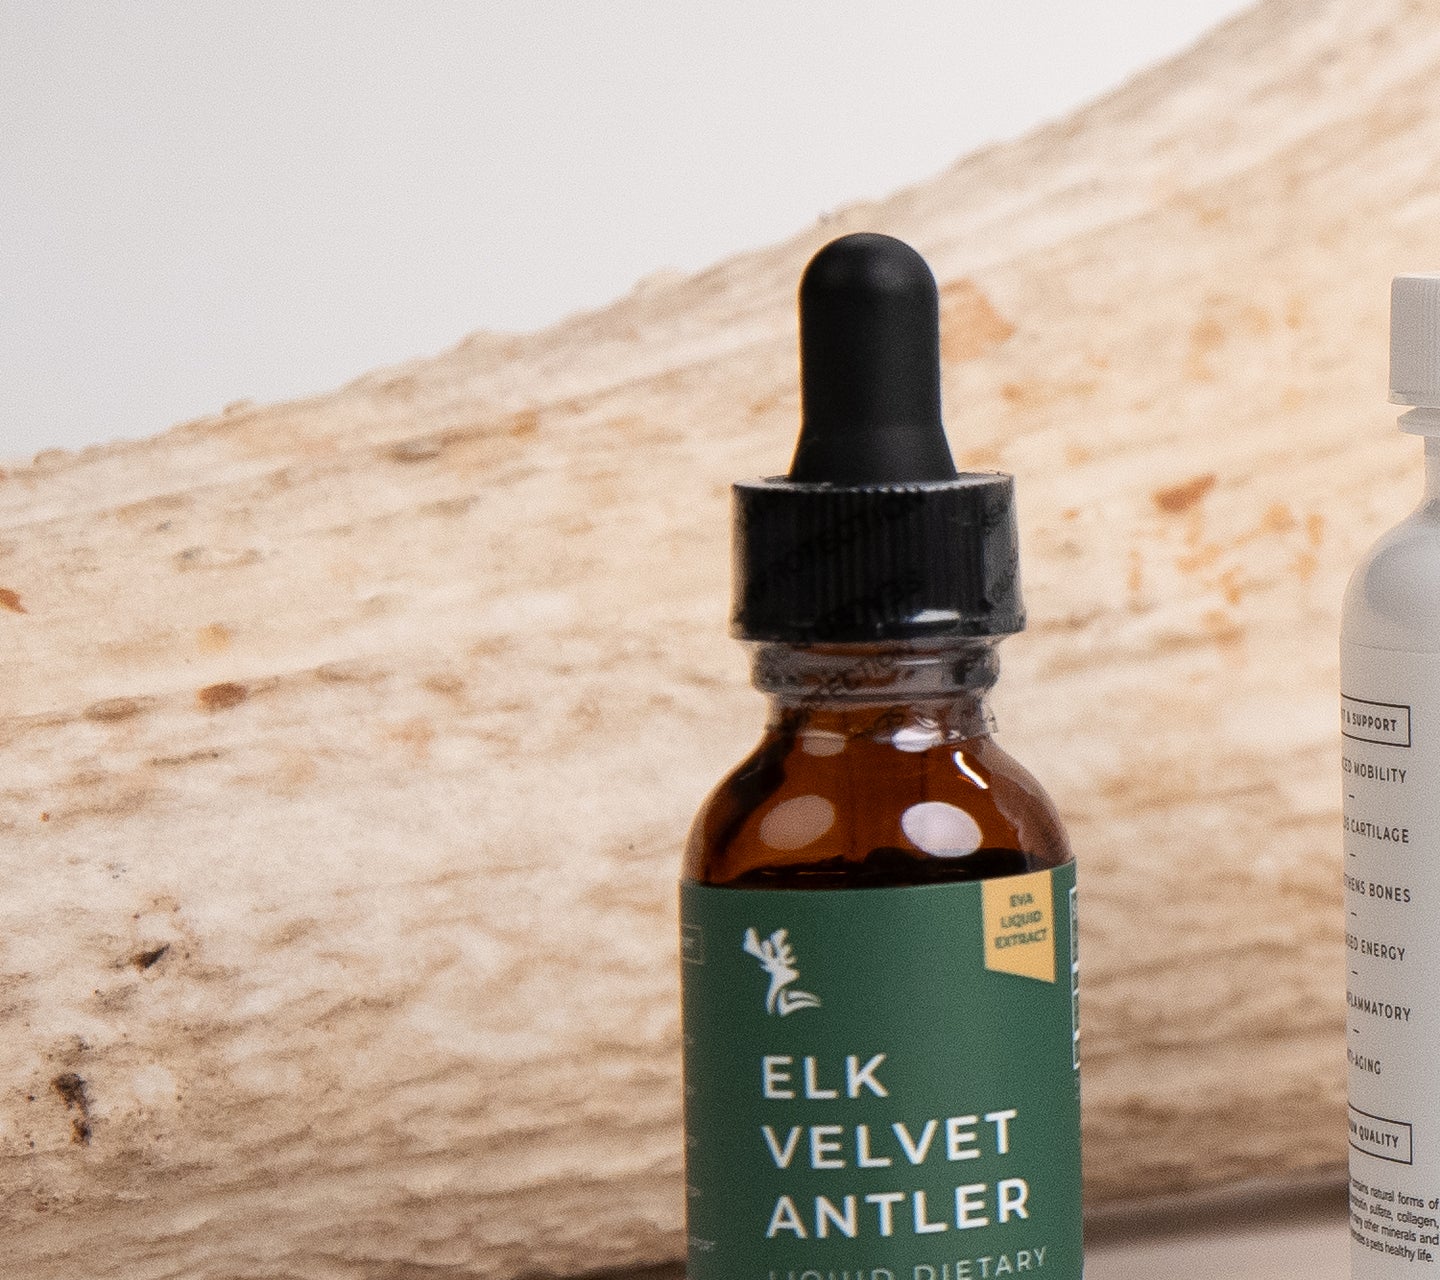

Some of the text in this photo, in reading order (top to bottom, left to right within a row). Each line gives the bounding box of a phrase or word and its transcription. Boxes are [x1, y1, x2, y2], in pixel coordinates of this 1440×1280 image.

[1352, 712, 1398, 732] SUPPORT
[1354, 761, 1407, 784] MOBILITY
[1351, 819, 1410, 843] CARTILAGE
[1009, 892, 1035, 909] EVA
[1369, 882, 1411, 903] BONES
[1001, 910, 1043, 929] LIQUID
[994, 928, 1048, 950] EXTRACT
[1361, 939, 1406, 962] ENERGY
[761, 1052, 890, 1101] ELK
[760, 1108, 1019, 1171] VELVET
[1358, 1125, 1400, 1149] QUALITY
[764, 1177, 1031, 1240] ANTLER
[1397, 1192, 1425, 1209] forms
[1428, 1197, 1440, 1210] of
[1397, 1210, 1440, 1230] collagen,
[1381, 1223, 1417, 1243] minerals
[1419, 1230, 1439, 1246] and
[1385, 1240, 1415, 1263] healthy
[1417, 1248, 1434, 1263] life.
